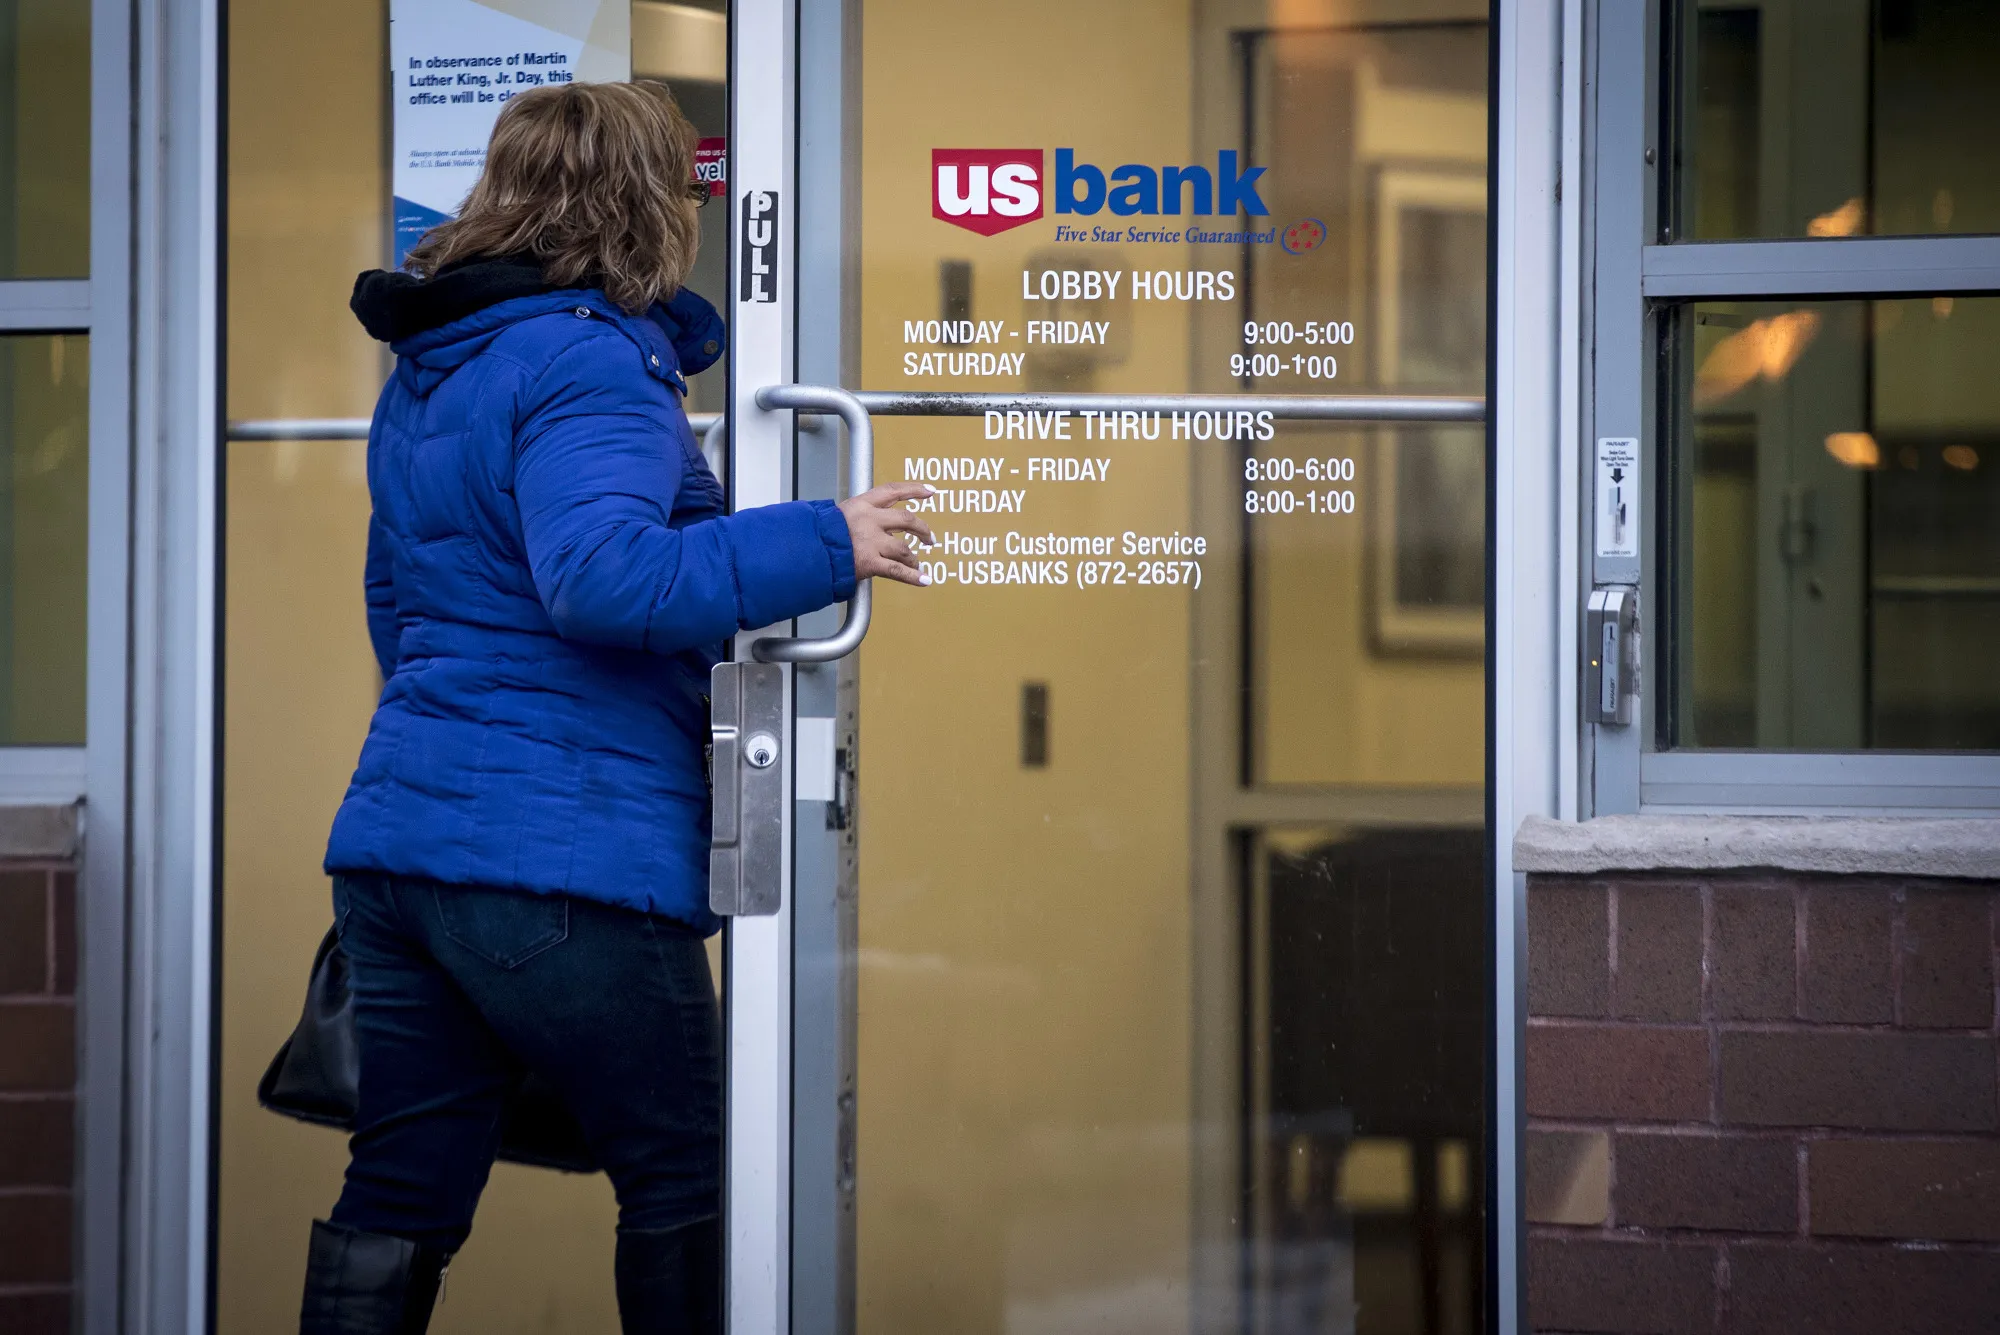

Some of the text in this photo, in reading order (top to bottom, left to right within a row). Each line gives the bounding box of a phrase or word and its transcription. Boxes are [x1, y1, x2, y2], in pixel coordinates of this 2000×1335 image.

[409, 52, 567, 69] In observance of Martin
[409, 70, 573, 87] Luther King, Jr. Day, this
[409, 92, 447, 105] office
[450, 91, 474, 103] will
[478, 90, 494, 102] be
[937, 148, 1270, 216] us bank
[1055, 226, 1275, 244] Five Star Service Guaranteed
[748, 193, 773, 302] PULL
[1023, 271, 1235, 301] LOBBY HOURS
[904, 321, 1004, 344] MONDAY
[1027, 322, 1110, 345] FRIDAY
[1244, 322, 1354, 345] 9:00-5:00
[903, 353, 1026, 376] SATURDAY
[984, 410, 1275, 441] DRIVE THRU HOURS
[904, 457, 1004, 481] MONDAY
[1028, 458, 1111, 481] FRIDAY
[1245, 458, 1355, 481] 8:00-6:00
[905, 489, 1026, 513] SATURDAY
[1245, 490, 1355, 514] 8:00-1:00
[1005, 531, 1113, 555] Customer
[1122, 532, 1206, 555] Service
[1076, 561, 1202, 589] (872-2657)
